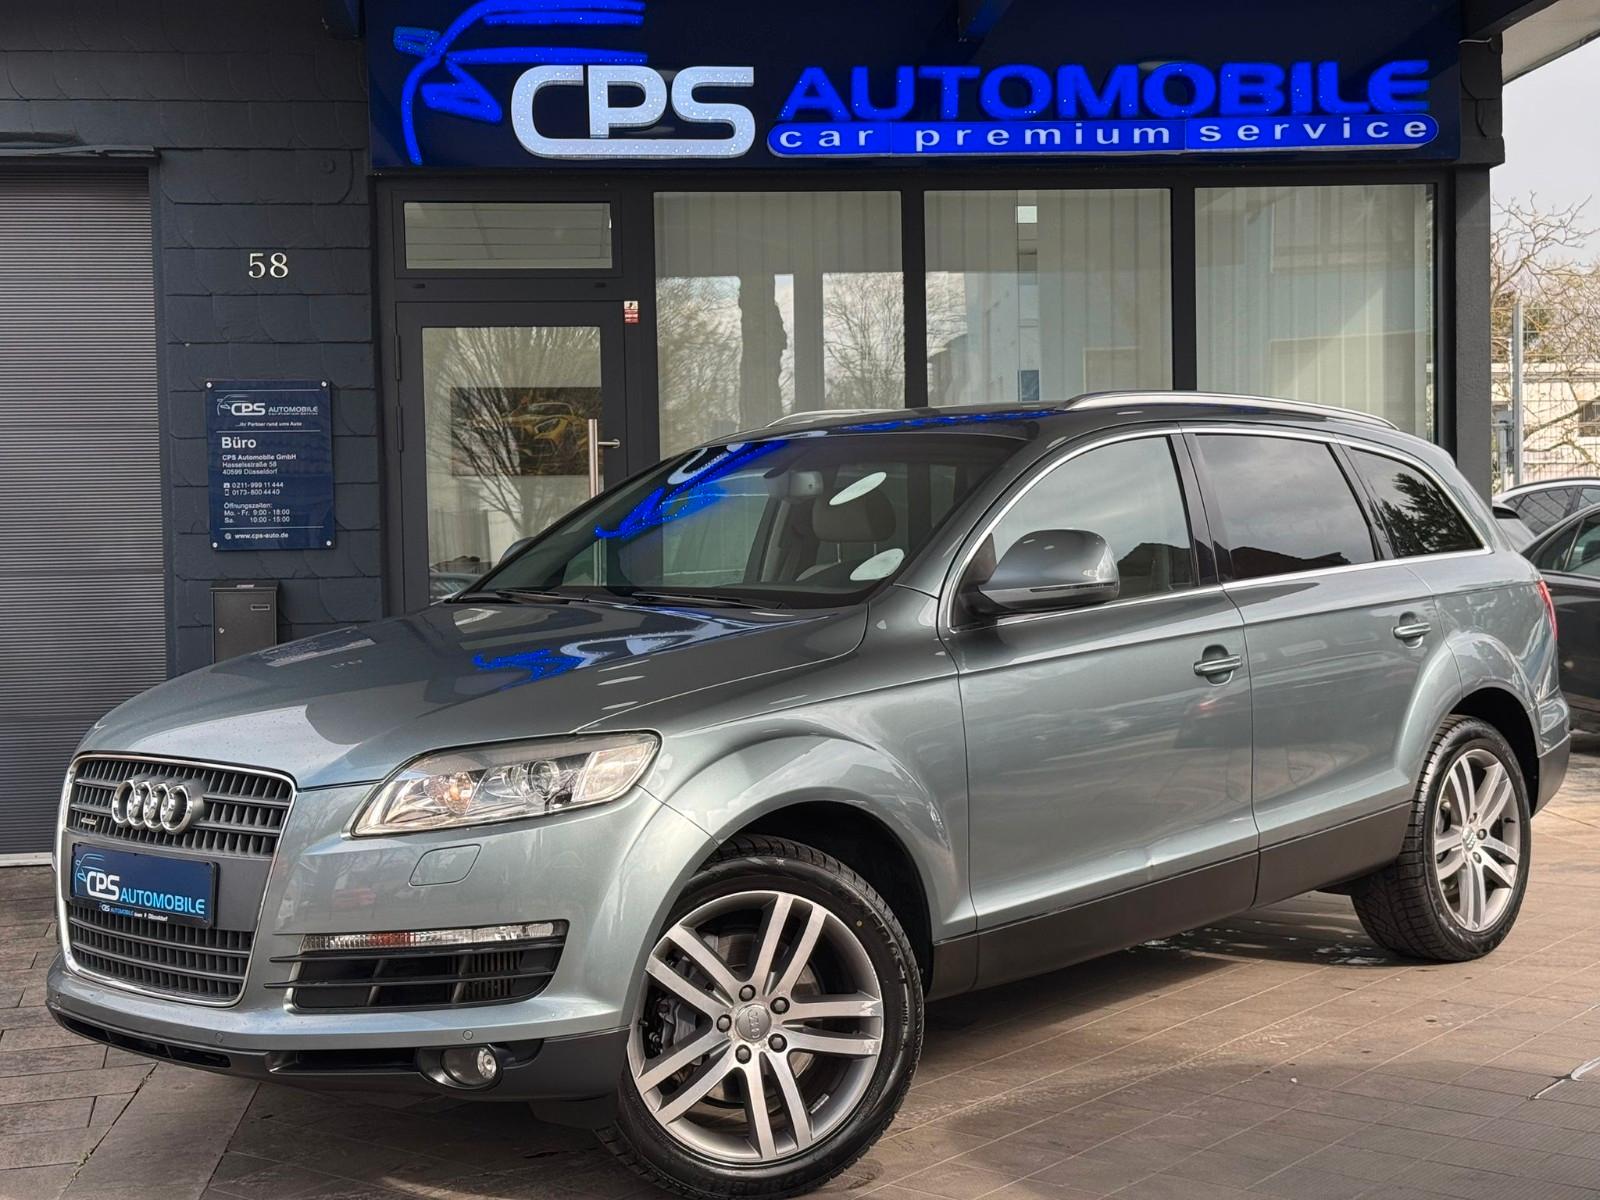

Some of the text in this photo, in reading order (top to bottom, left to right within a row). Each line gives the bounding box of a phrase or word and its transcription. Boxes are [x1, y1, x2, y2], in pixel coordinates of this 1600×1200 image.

[510, 60, 1430, 159] CPS AUTOMOBILE
[779, 115, 1428, 152] car premium service
[248, 252, 289, 278] 58
[231, 402, 266, 416] CPS
[221, 436, 257, 449] Büro
[238, 453, 275, 461] Automobile
[223, 501, 273, 510] Öffnungszeiten:
[86, 870, 206, 915] CPS AUTOMOBILE
